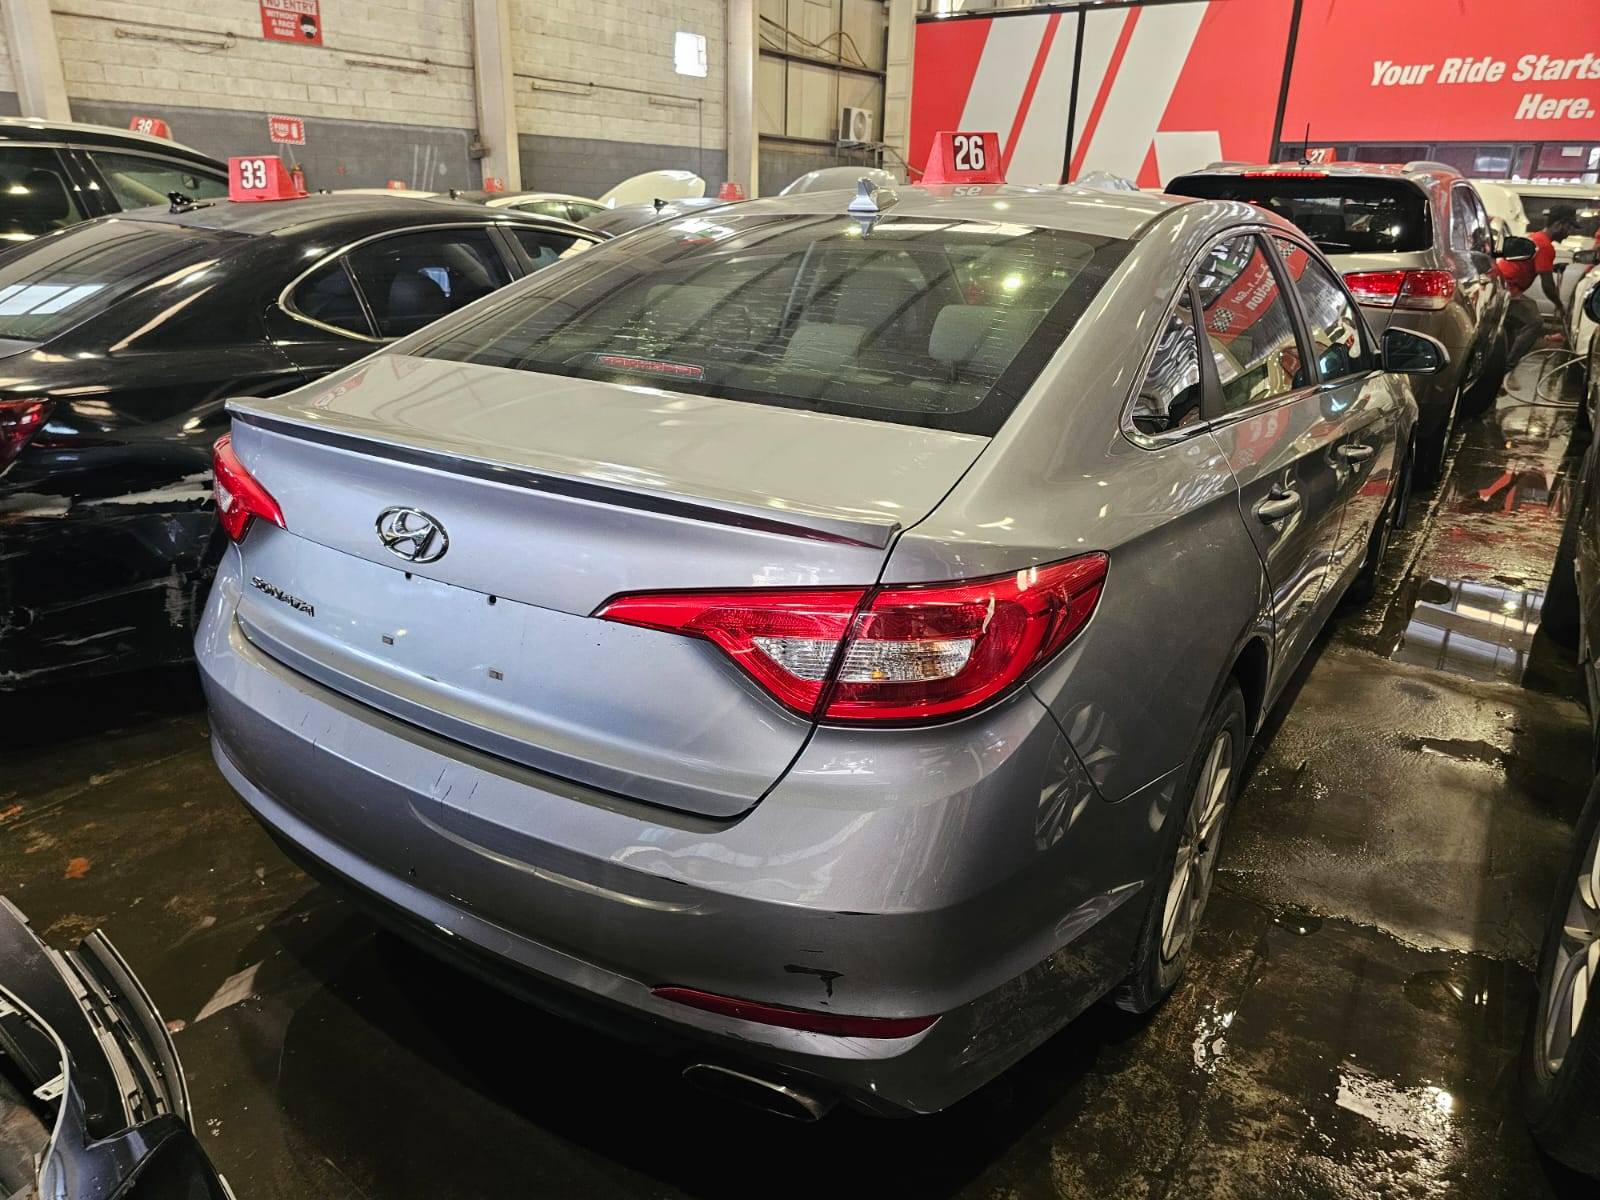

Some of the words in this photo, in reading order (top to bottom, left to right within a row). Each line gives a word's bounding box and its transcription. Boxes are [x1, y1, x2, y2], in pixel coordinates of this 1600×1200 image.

[1371, 60, 1435, 87] Your
[1437, 56, 1506, 83] Ride
[1511, 52, 1600, 82] Starts
[1514, 93, 1595, 120] Here.
[954, 135, 984, 170] 26
[1310, 149, 1326, 163] 27
[240, 159, 267, 189] 33
[249, 575, 316, 618] SONATA
